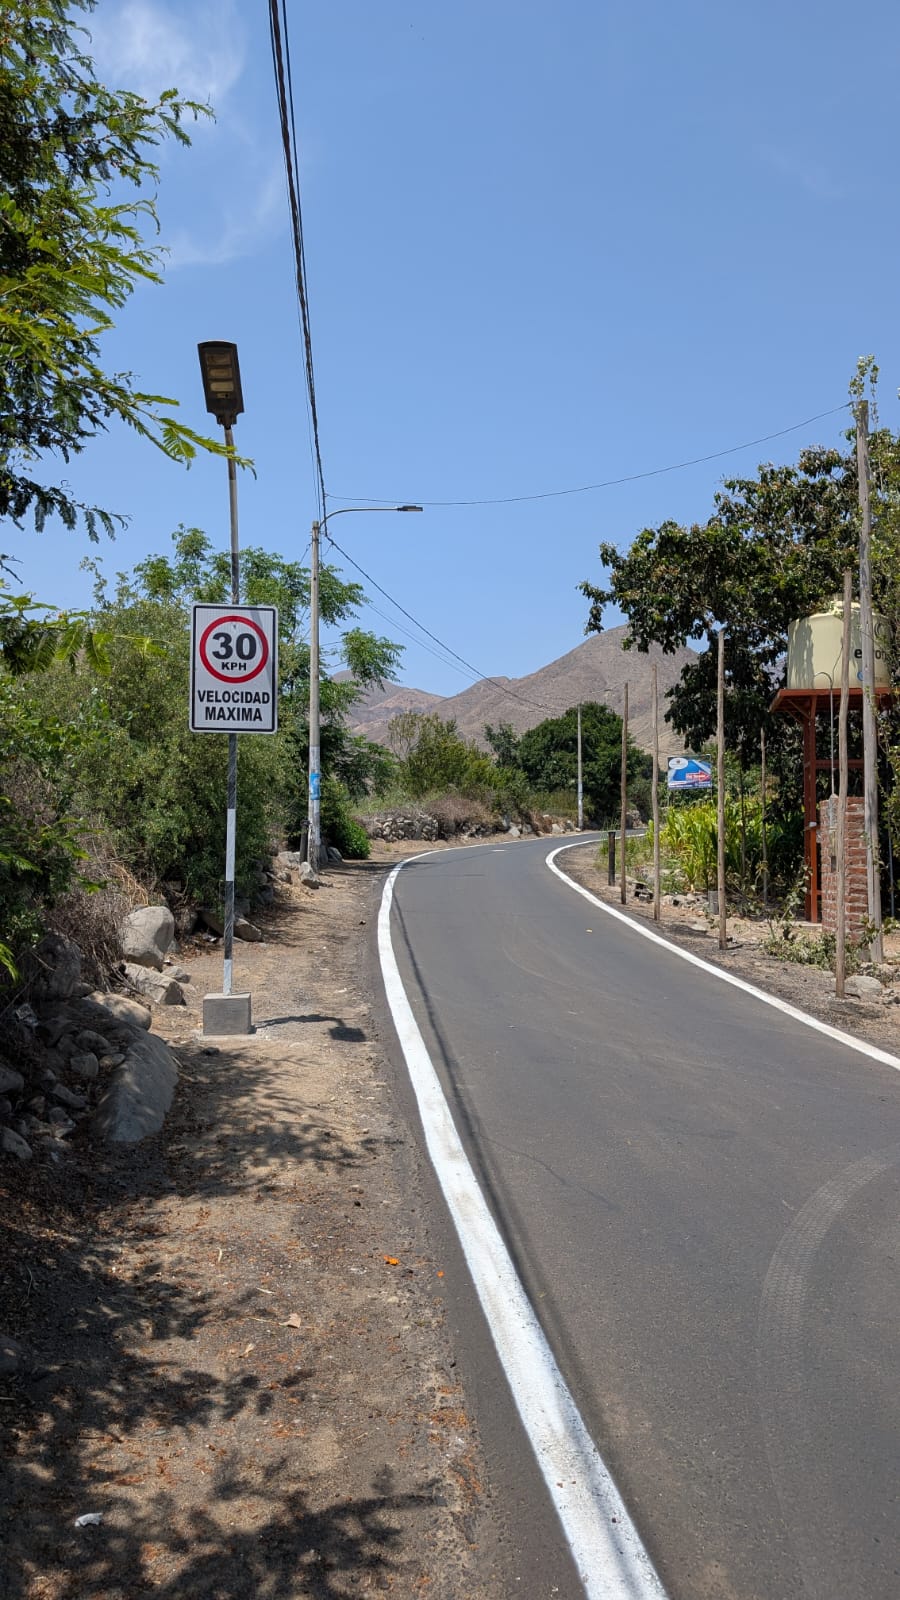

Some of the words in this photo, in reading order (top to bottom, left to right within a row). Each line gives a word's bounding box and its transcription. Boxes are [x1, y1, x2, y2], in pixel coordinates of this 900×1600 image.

[212, 632, 257, 660] 30
[221, 661, 246, 671] KPH
[197, 690, 270, 704] VELOCIDAD
[205, 707, 262, 721] MAXIMA
